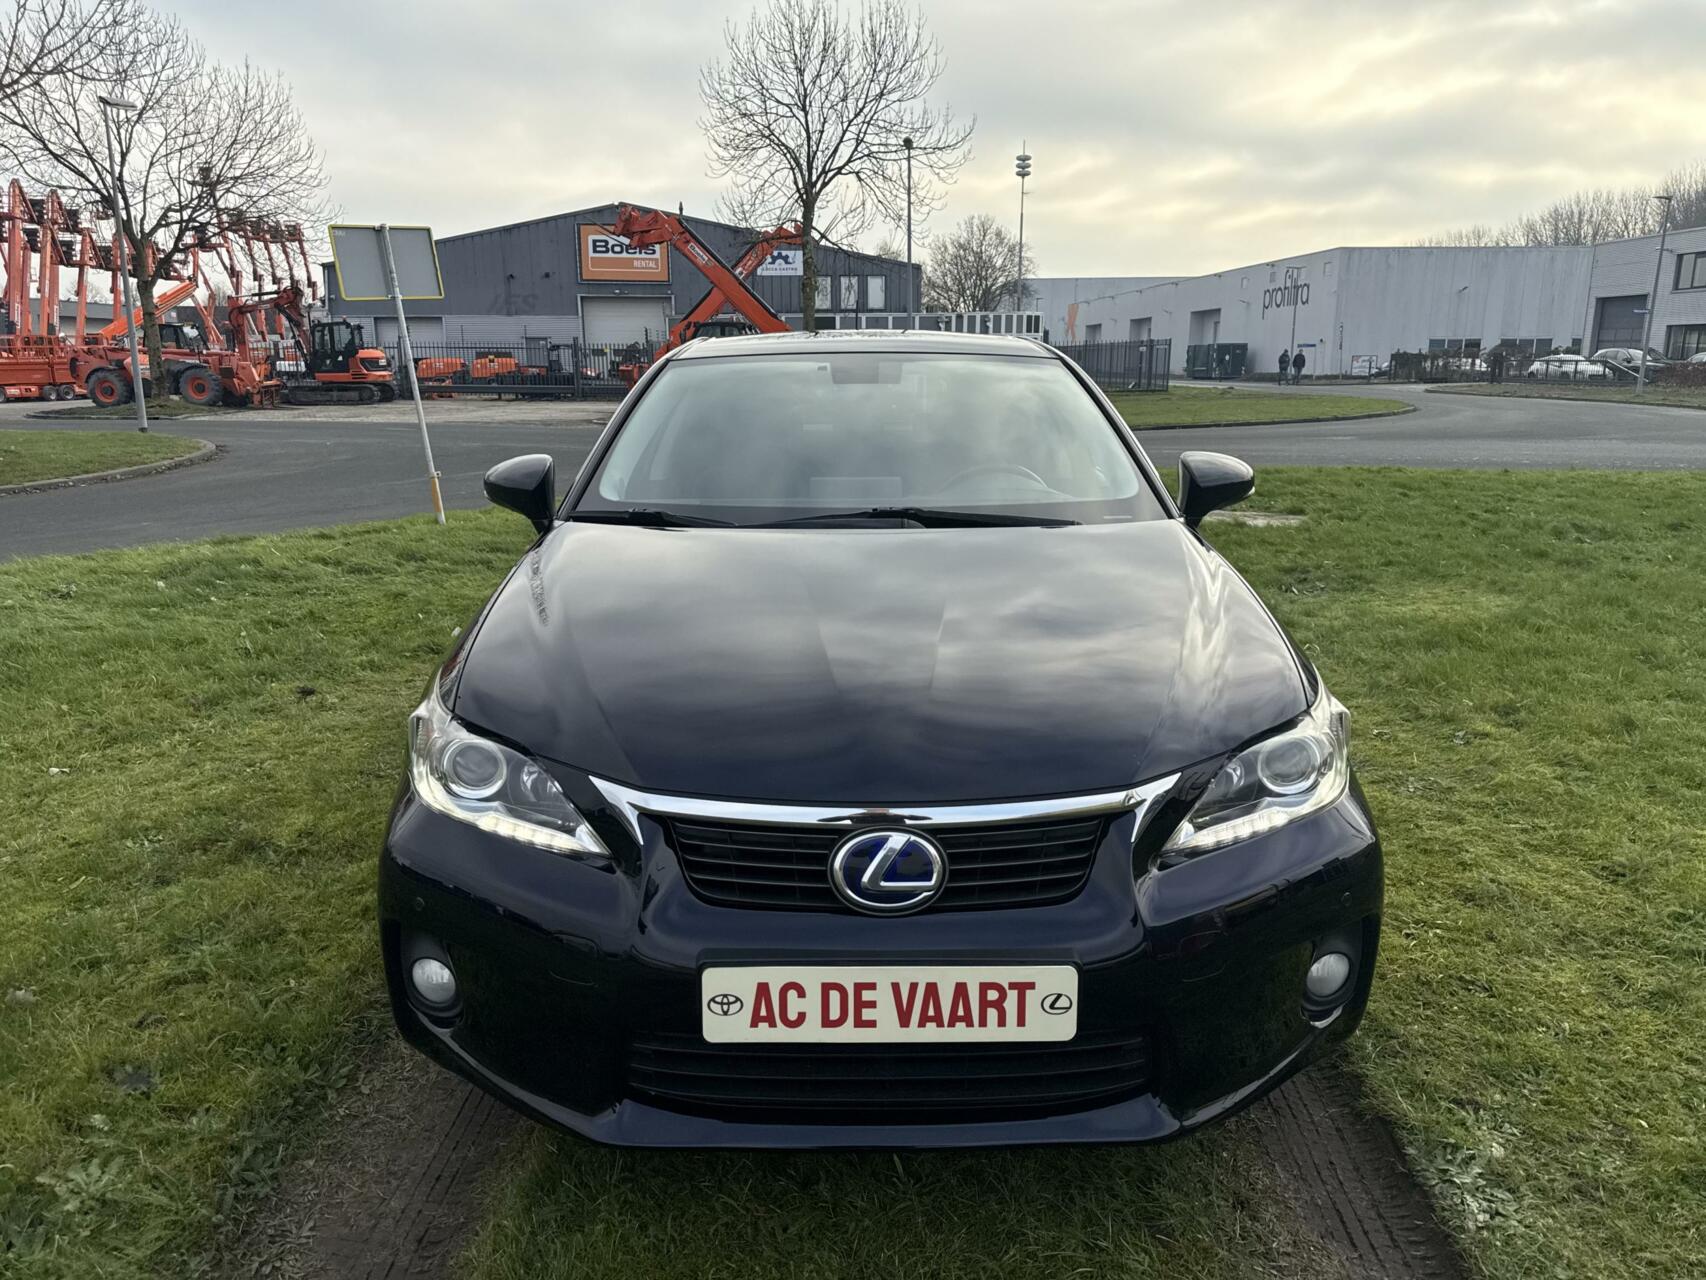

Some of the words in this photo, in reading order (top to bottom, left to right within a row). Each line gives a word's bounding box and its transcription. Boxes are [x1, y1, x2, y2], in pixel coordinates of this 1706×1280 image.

[633, 259, 657, 268] RENTAL
[1262, 269, 1310, 320] profiltra
[749, 982, 807, 1029] AC
[820, 982, 878, 1029] DE
[890, 981, 1036, 1029] VAART
